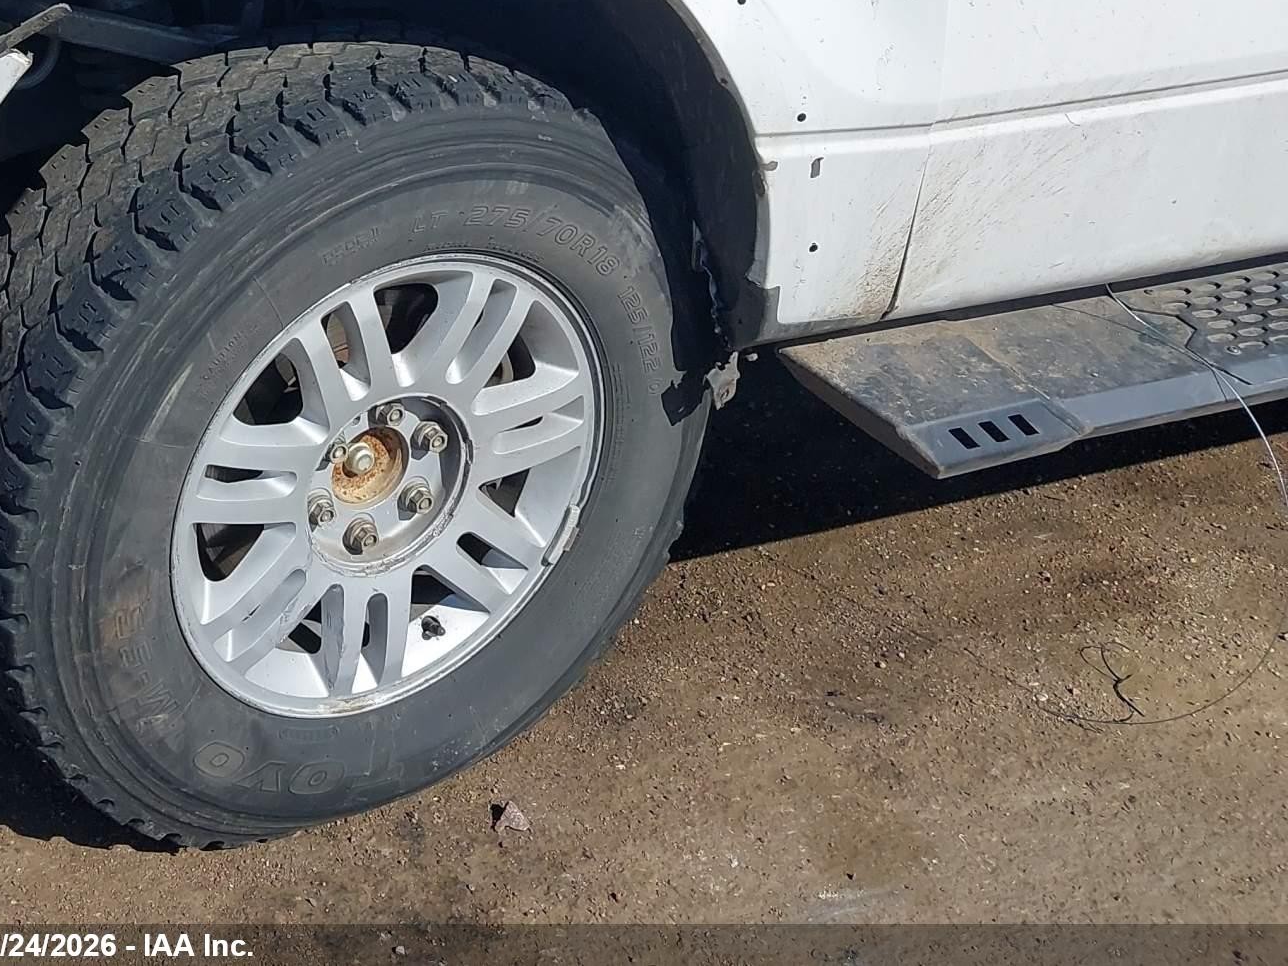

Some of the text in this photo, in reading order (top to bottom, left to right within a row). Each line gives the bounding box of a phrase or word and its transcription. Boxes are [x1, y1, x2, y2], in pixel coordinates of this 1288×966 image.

[409, 209, 452, 235] LT
[463, 203, 622, 277] 275/70R18
[616, 284, 661, 374] 125/122
